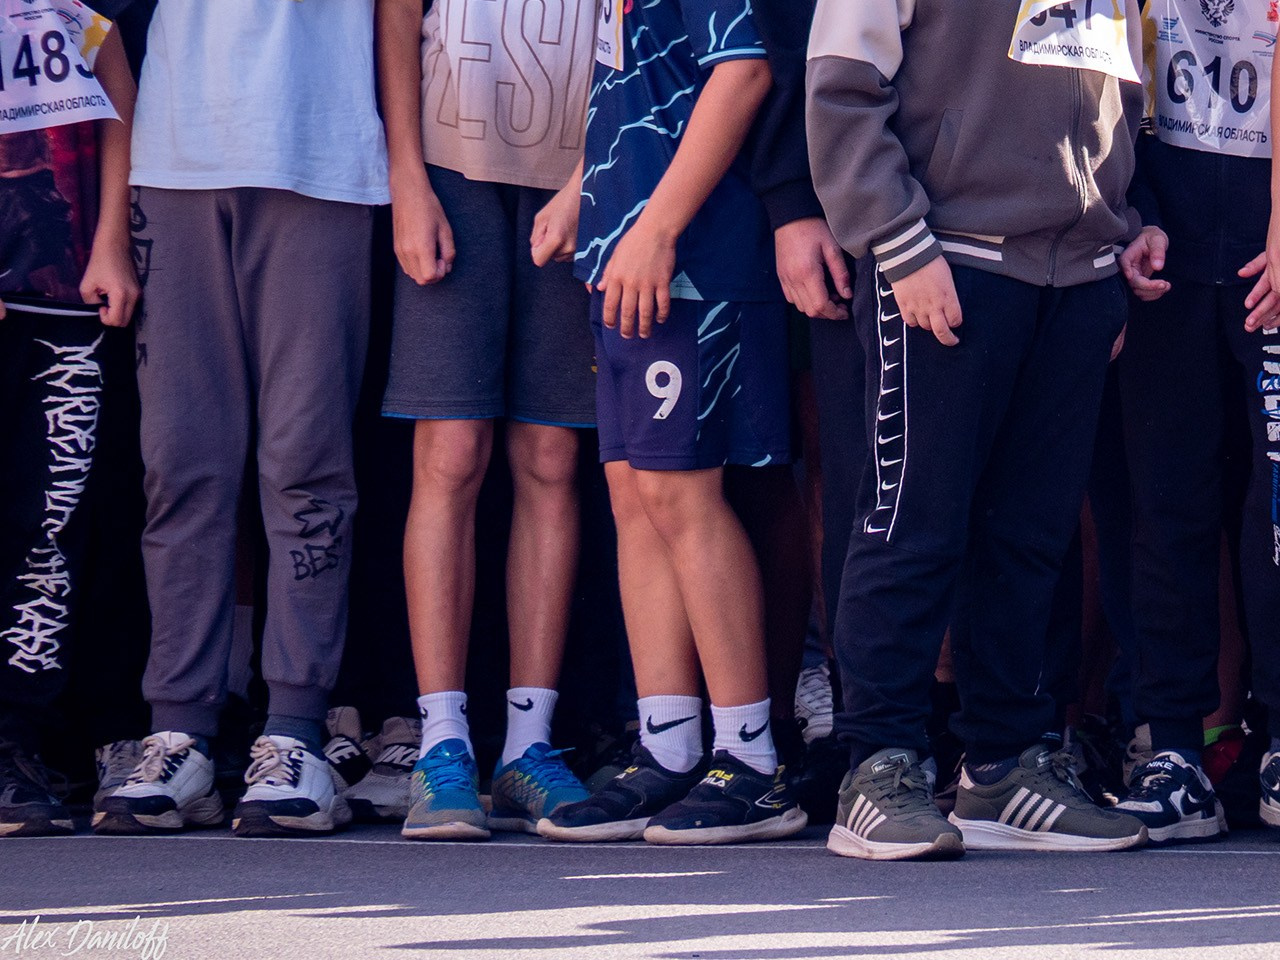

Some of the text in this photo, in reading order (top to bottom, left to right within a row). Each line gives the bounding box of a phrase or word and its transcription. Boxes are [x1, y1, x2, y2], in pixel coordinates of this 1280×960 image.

[1020, 39, 1084, 57] ВЛАДИМИРСКАЯ
[1167, 50, 1258, 113] 610
[65, 94, 106, 110] ОБЛАСТЬ
[1158, 115, 1268, 143] ВЛАДИМИРСКАЯ ОБЛАСТЬ
[645, 360, 682, 420] 9
[1147, 760, 1175, 771] NIKE
[700, 777, 727, 788] FILA
